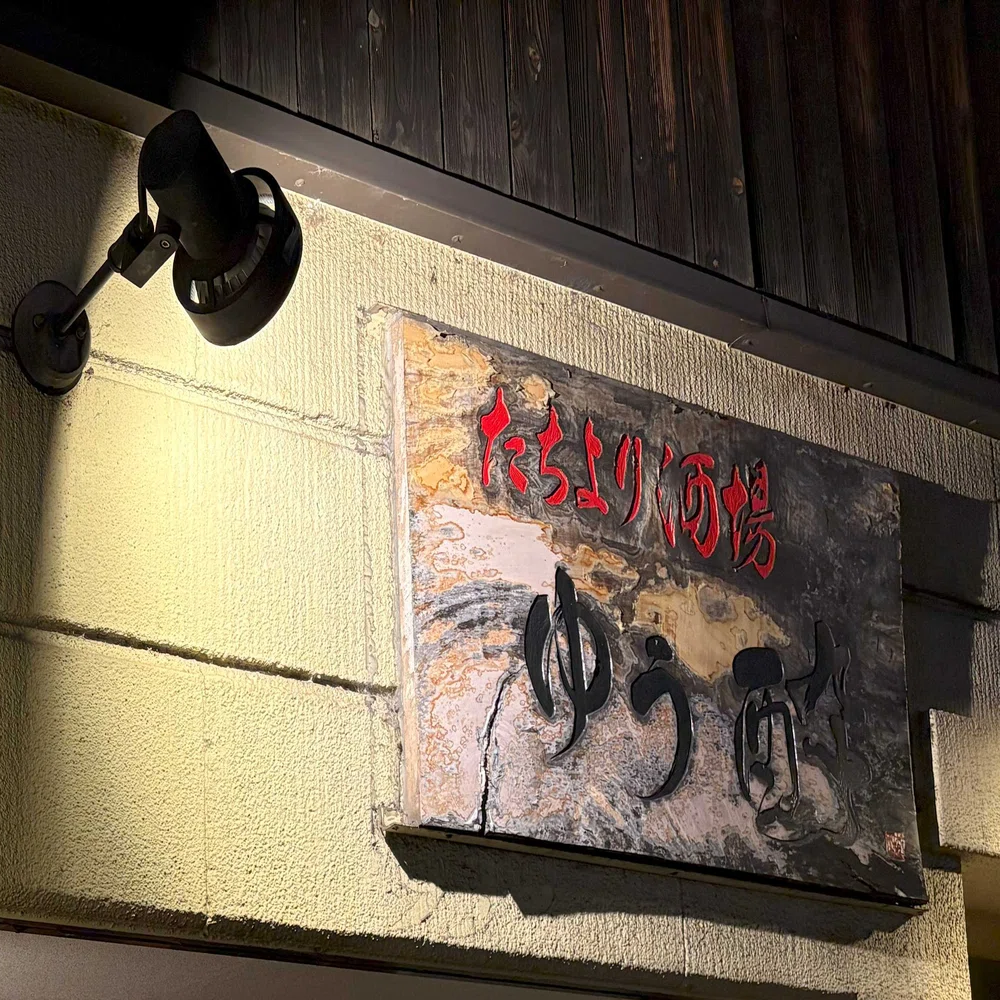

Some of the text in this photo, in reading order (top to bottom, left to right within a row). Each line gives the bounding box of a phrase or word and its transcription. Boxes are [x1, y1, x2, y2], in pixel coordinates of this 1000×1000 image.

[480, 387, 778, 580] たちより酒場
